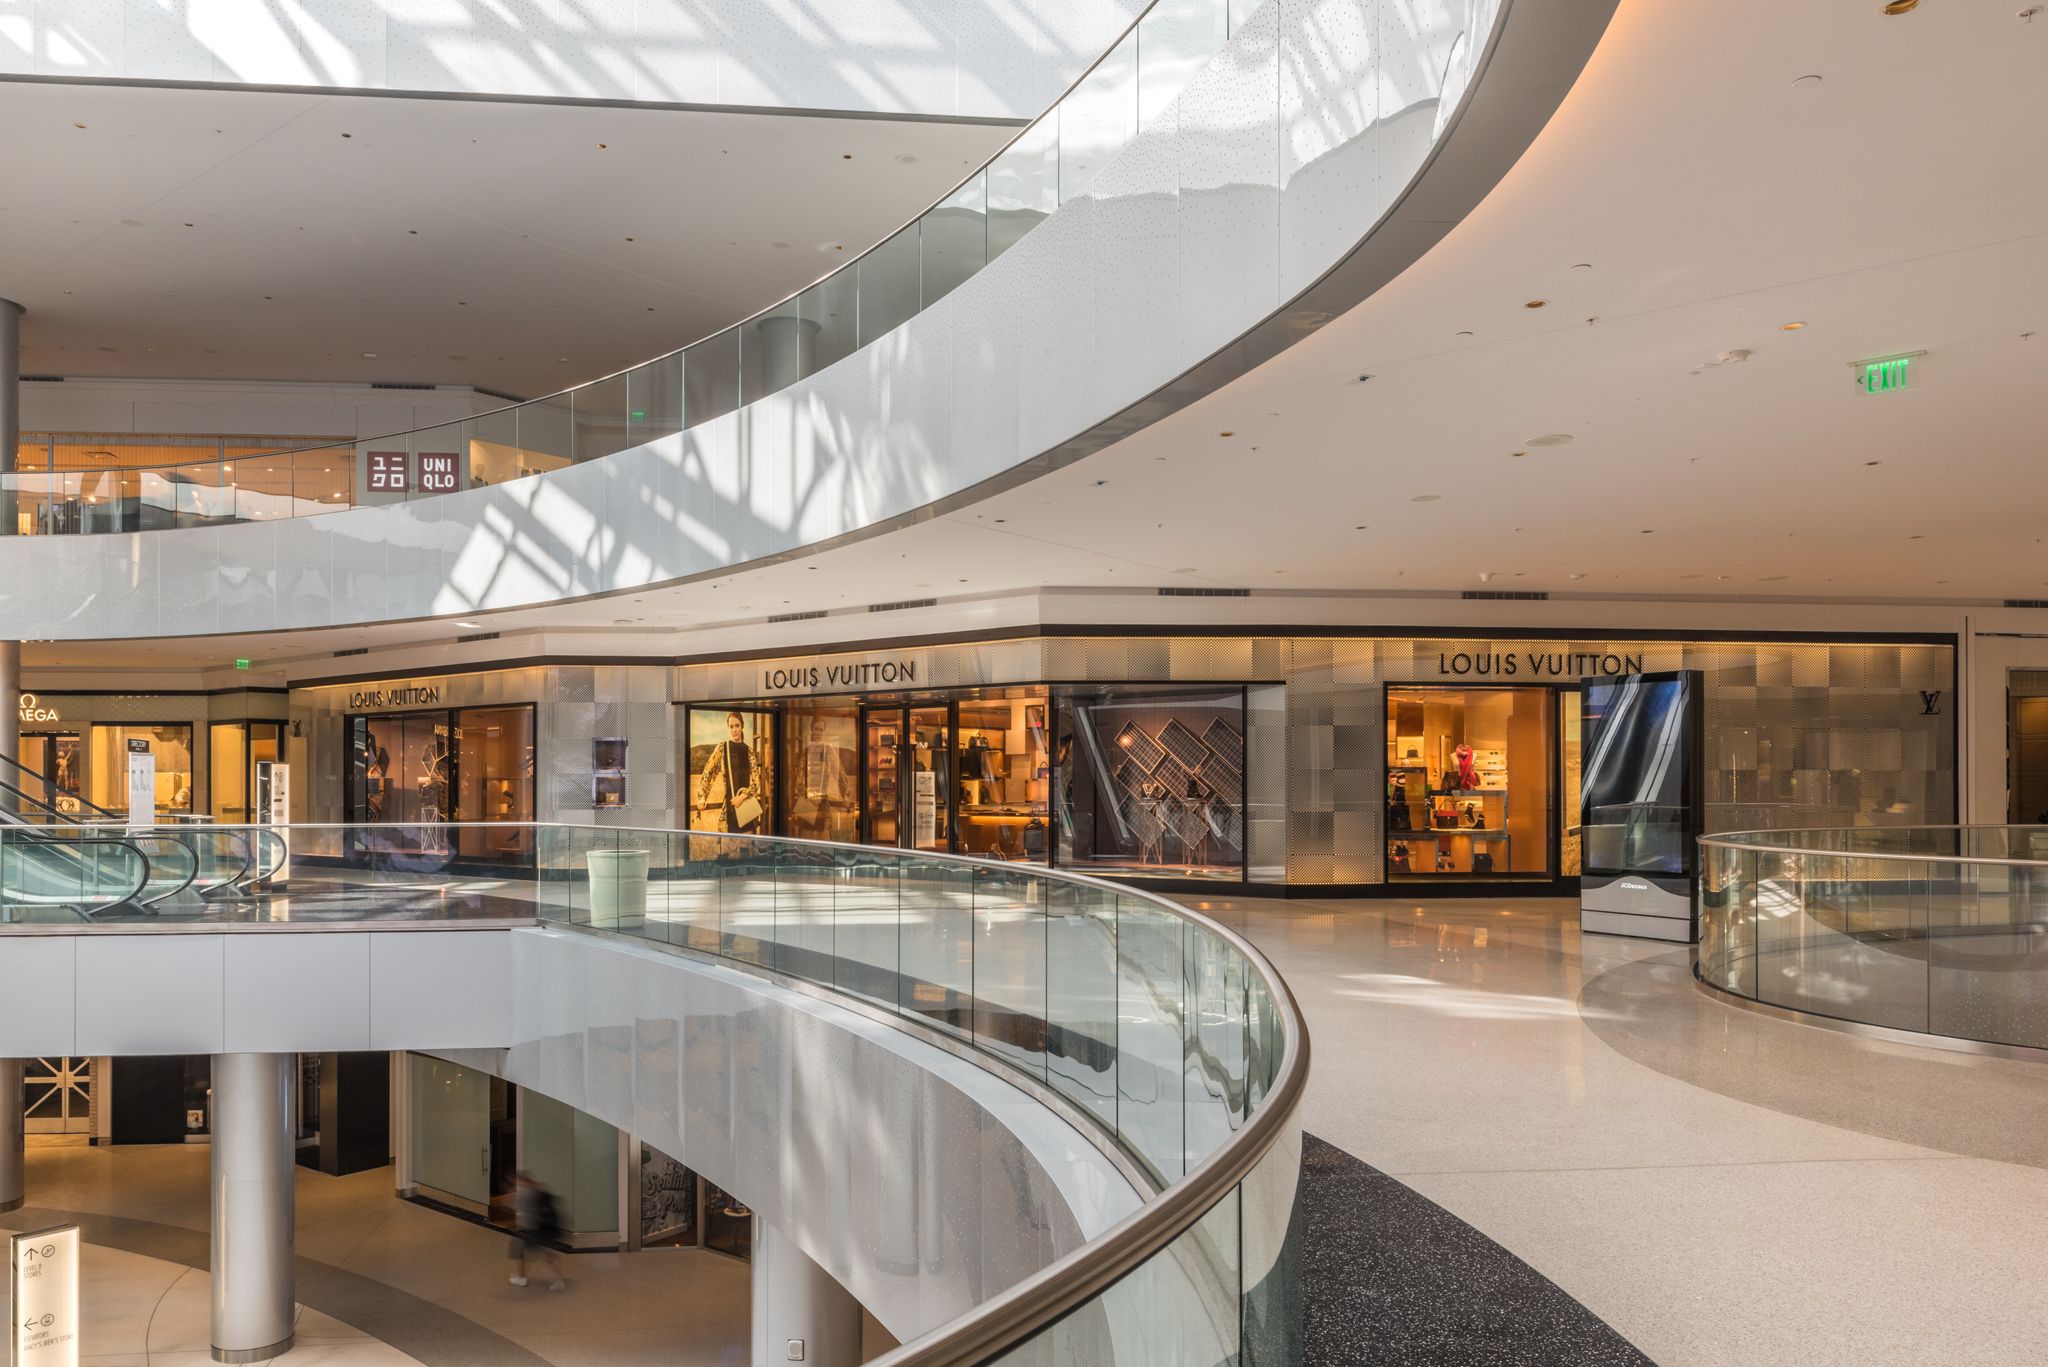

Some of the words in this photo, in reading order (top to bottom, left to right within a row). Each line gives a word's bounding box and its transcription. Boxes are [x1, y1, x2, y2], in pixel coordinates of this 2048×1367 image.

[1867, 359, 1909, 394] EXIT
[423, 458, 452, 472] UNI
[423, 474, 454, 490] QLO
[1440, 653, 1517, 674] LOUIS
[1529, 653, 1643, 675] VUITTON
[765, 667, 819, 689] LOUIS
[826, 661, 915, 686] VUITTON
[349, 689, 384, 708] LOUIS
[387, 686, 440, 707] VUITTON
[1621, 882, 1648, 890] JCDecaux
[23, 1270, 42, 1279] STORES
